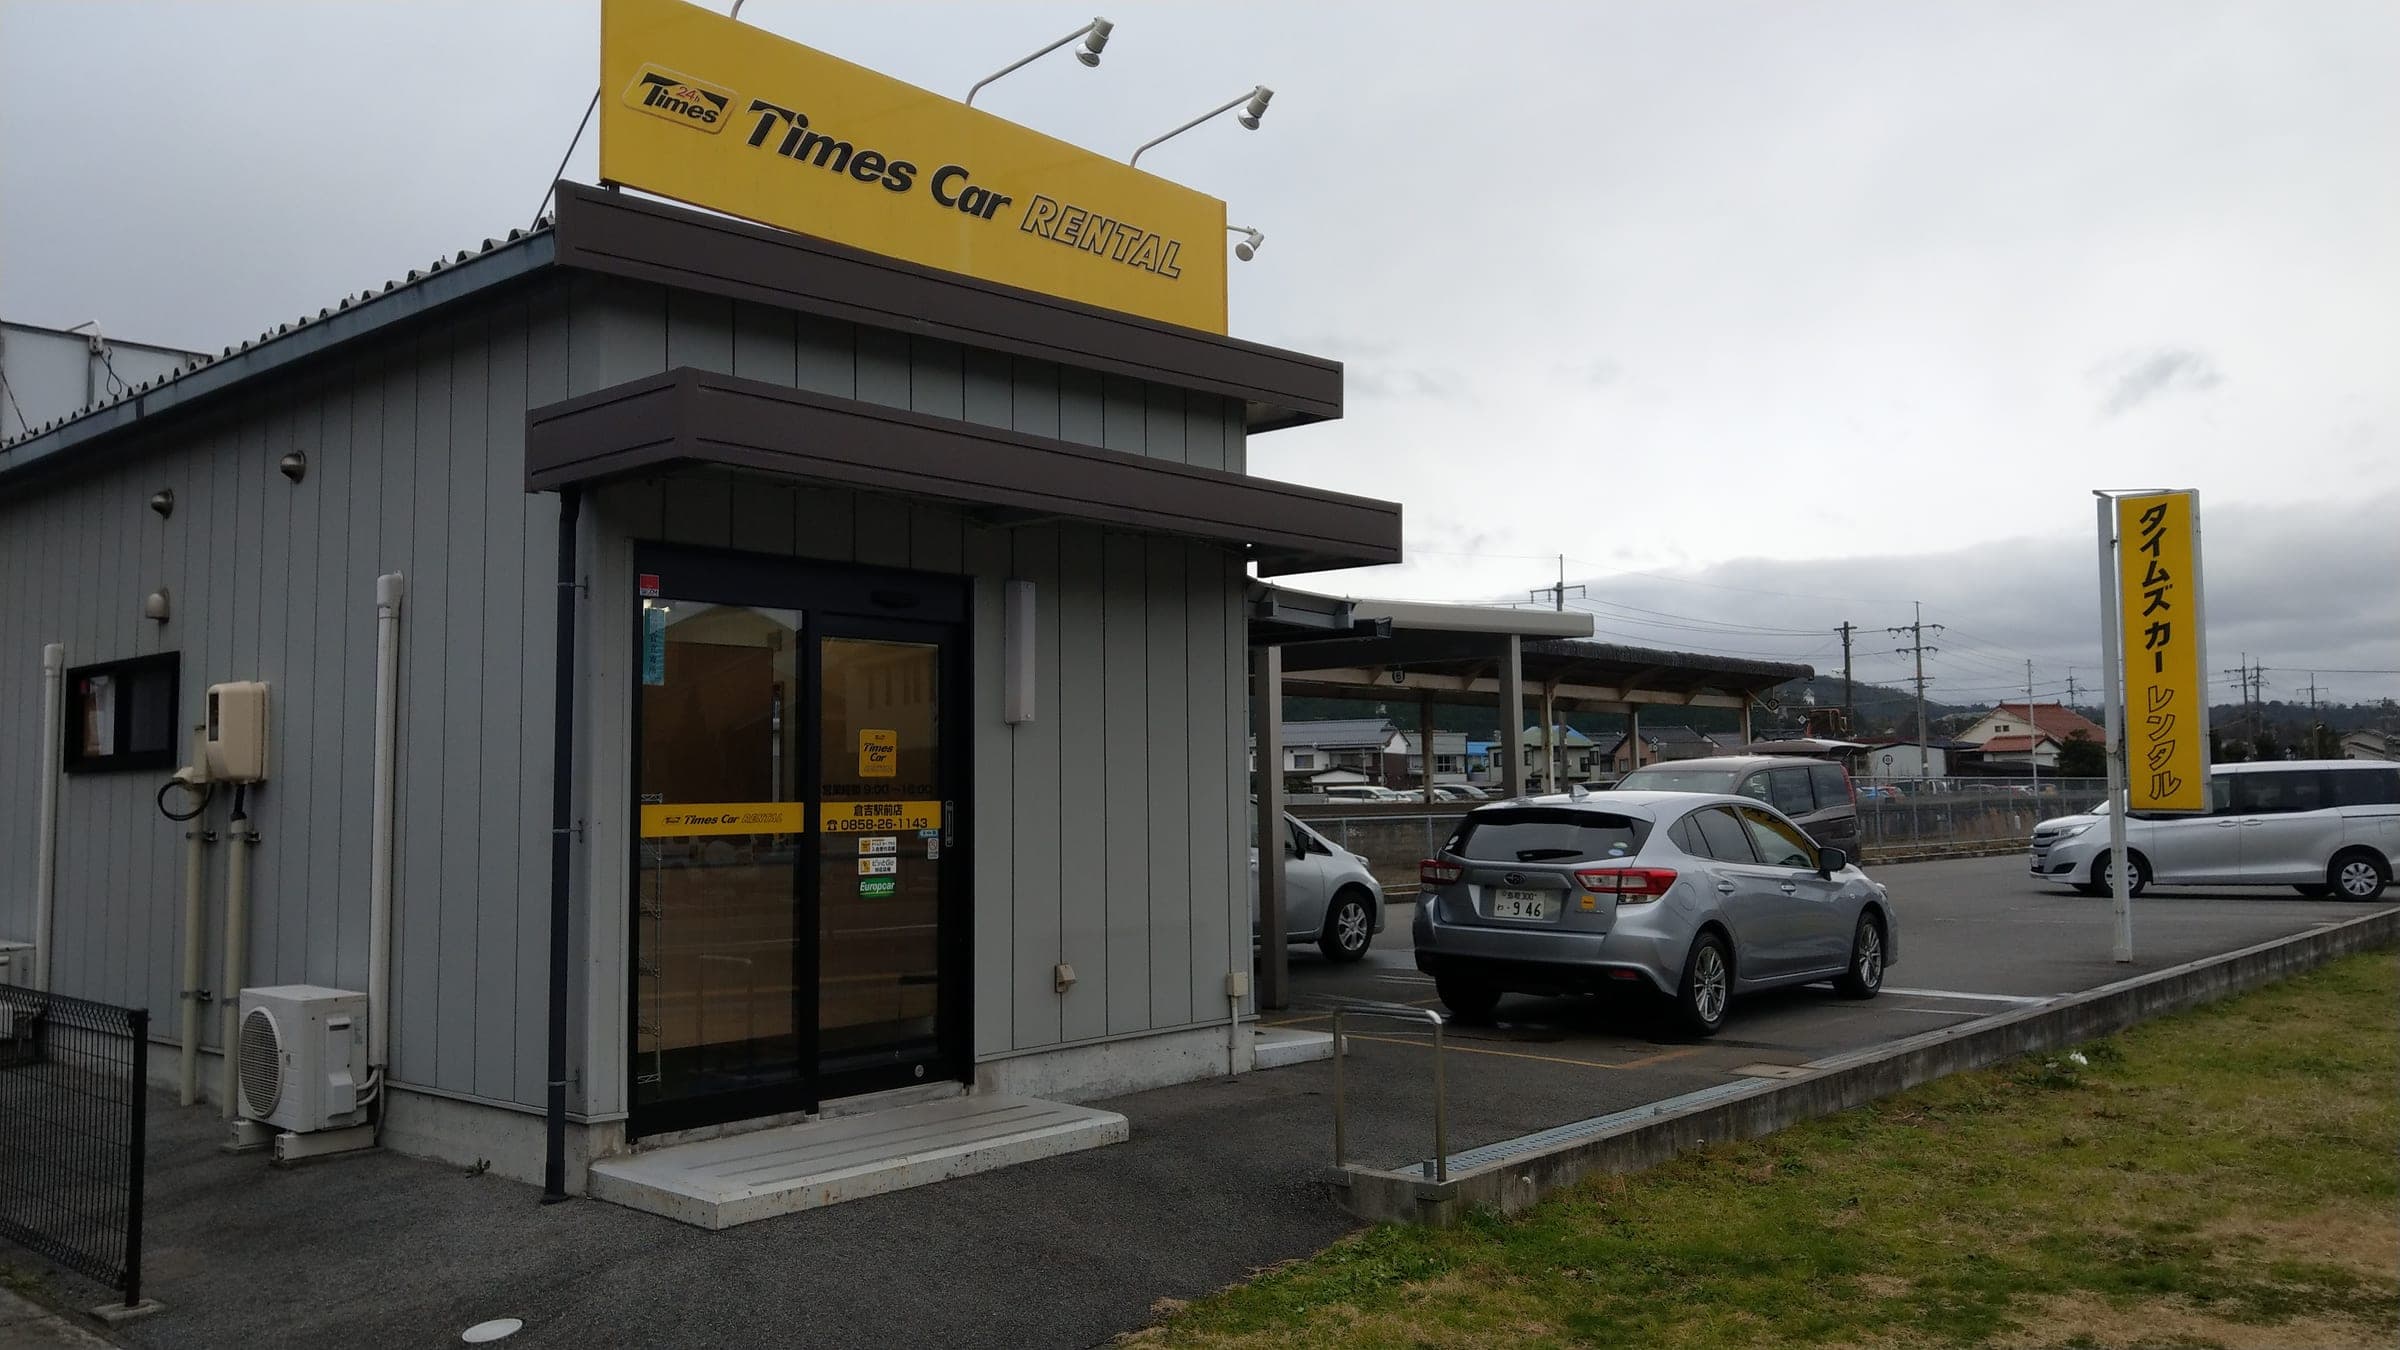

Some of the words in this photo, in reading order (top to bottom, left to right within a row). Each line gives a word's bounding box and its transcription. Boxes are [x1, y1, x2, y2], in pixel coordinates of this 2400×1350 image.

[639, 72, 720, 124] Times
[749, 99, 917, 191] Times
[931, 165, 1012, 220] Car
[1020, 194, 1181, 278] RENTAL
[864, 742, 894, 753] Times
[870, 752, 887, 762] Car
[853, 804, 903, 817] 倉吉駅前店
[684, 814, 718, 825] Times
[721, 813, 740, 824] Car
[860, 881, 896, 893] Europcar
